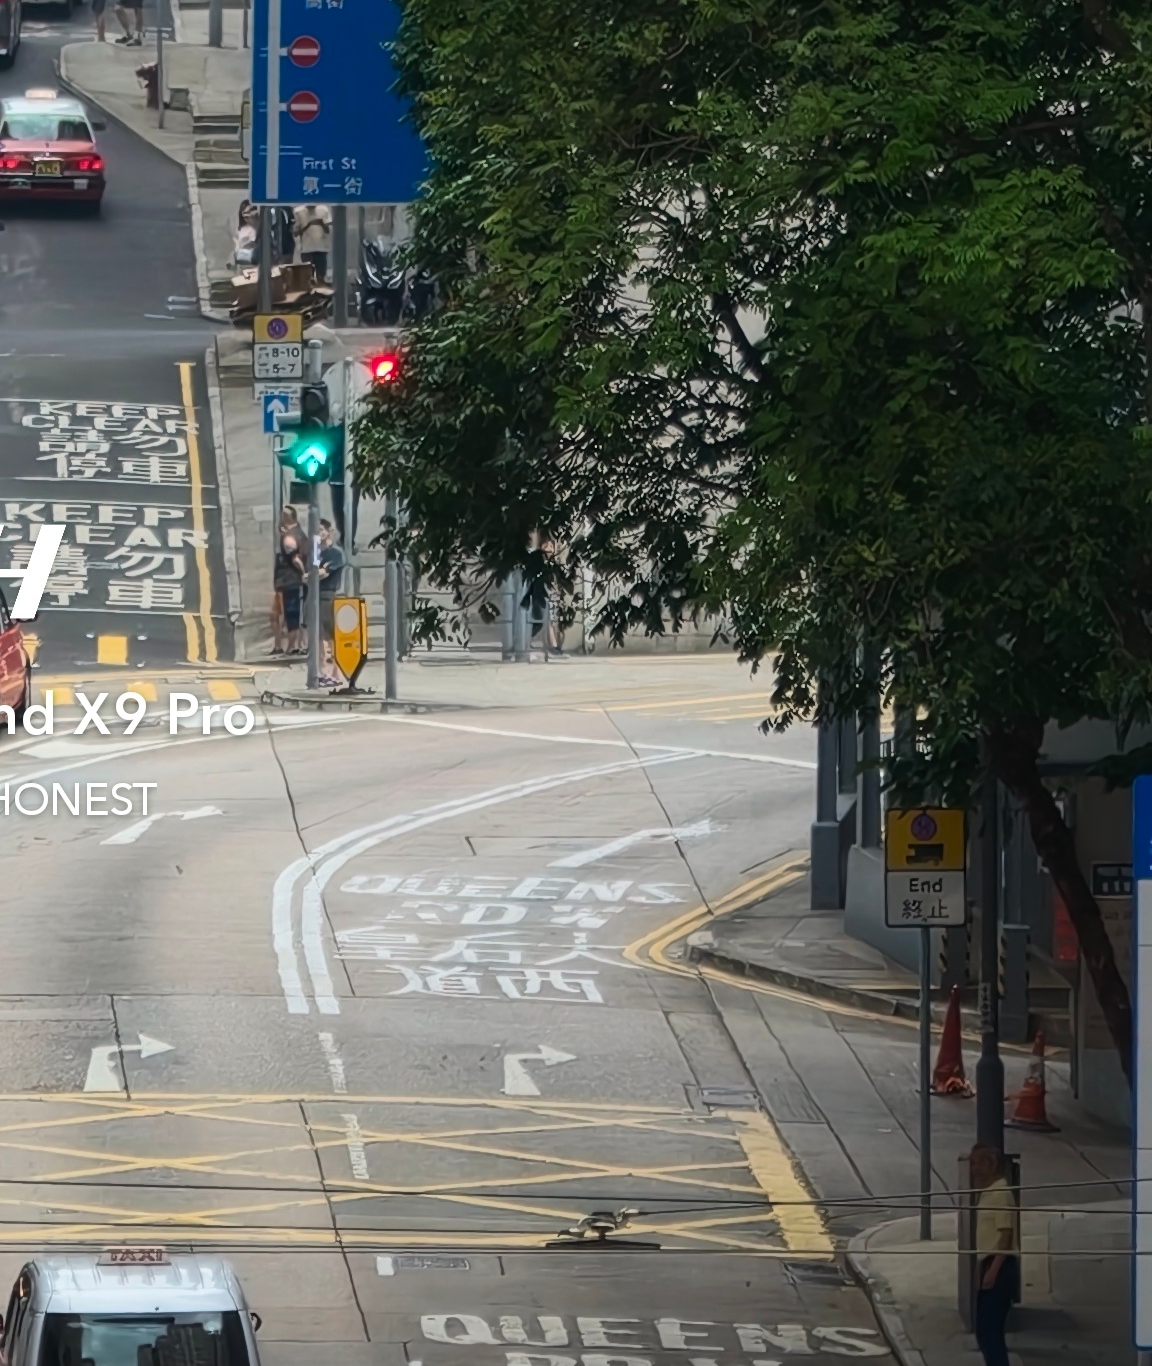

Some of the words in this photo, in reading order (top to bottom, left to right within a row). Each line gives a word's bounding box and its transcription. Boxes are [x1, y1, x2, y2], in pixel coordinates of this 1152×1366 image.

[302, 157, 334, 170] First
[341, 157, 356, 170] St
[40, 402, 181, 419] KEEP
[22, 414, 200, 435] CLEAR
[5, 503, 185, 527] KEEP
[340, 874, 693, 904] QUEENS
[909, 878, 943, 893] End
[902, 898, 949, 922] 終止
[420, 1314, 892, 1357] QUEENS
